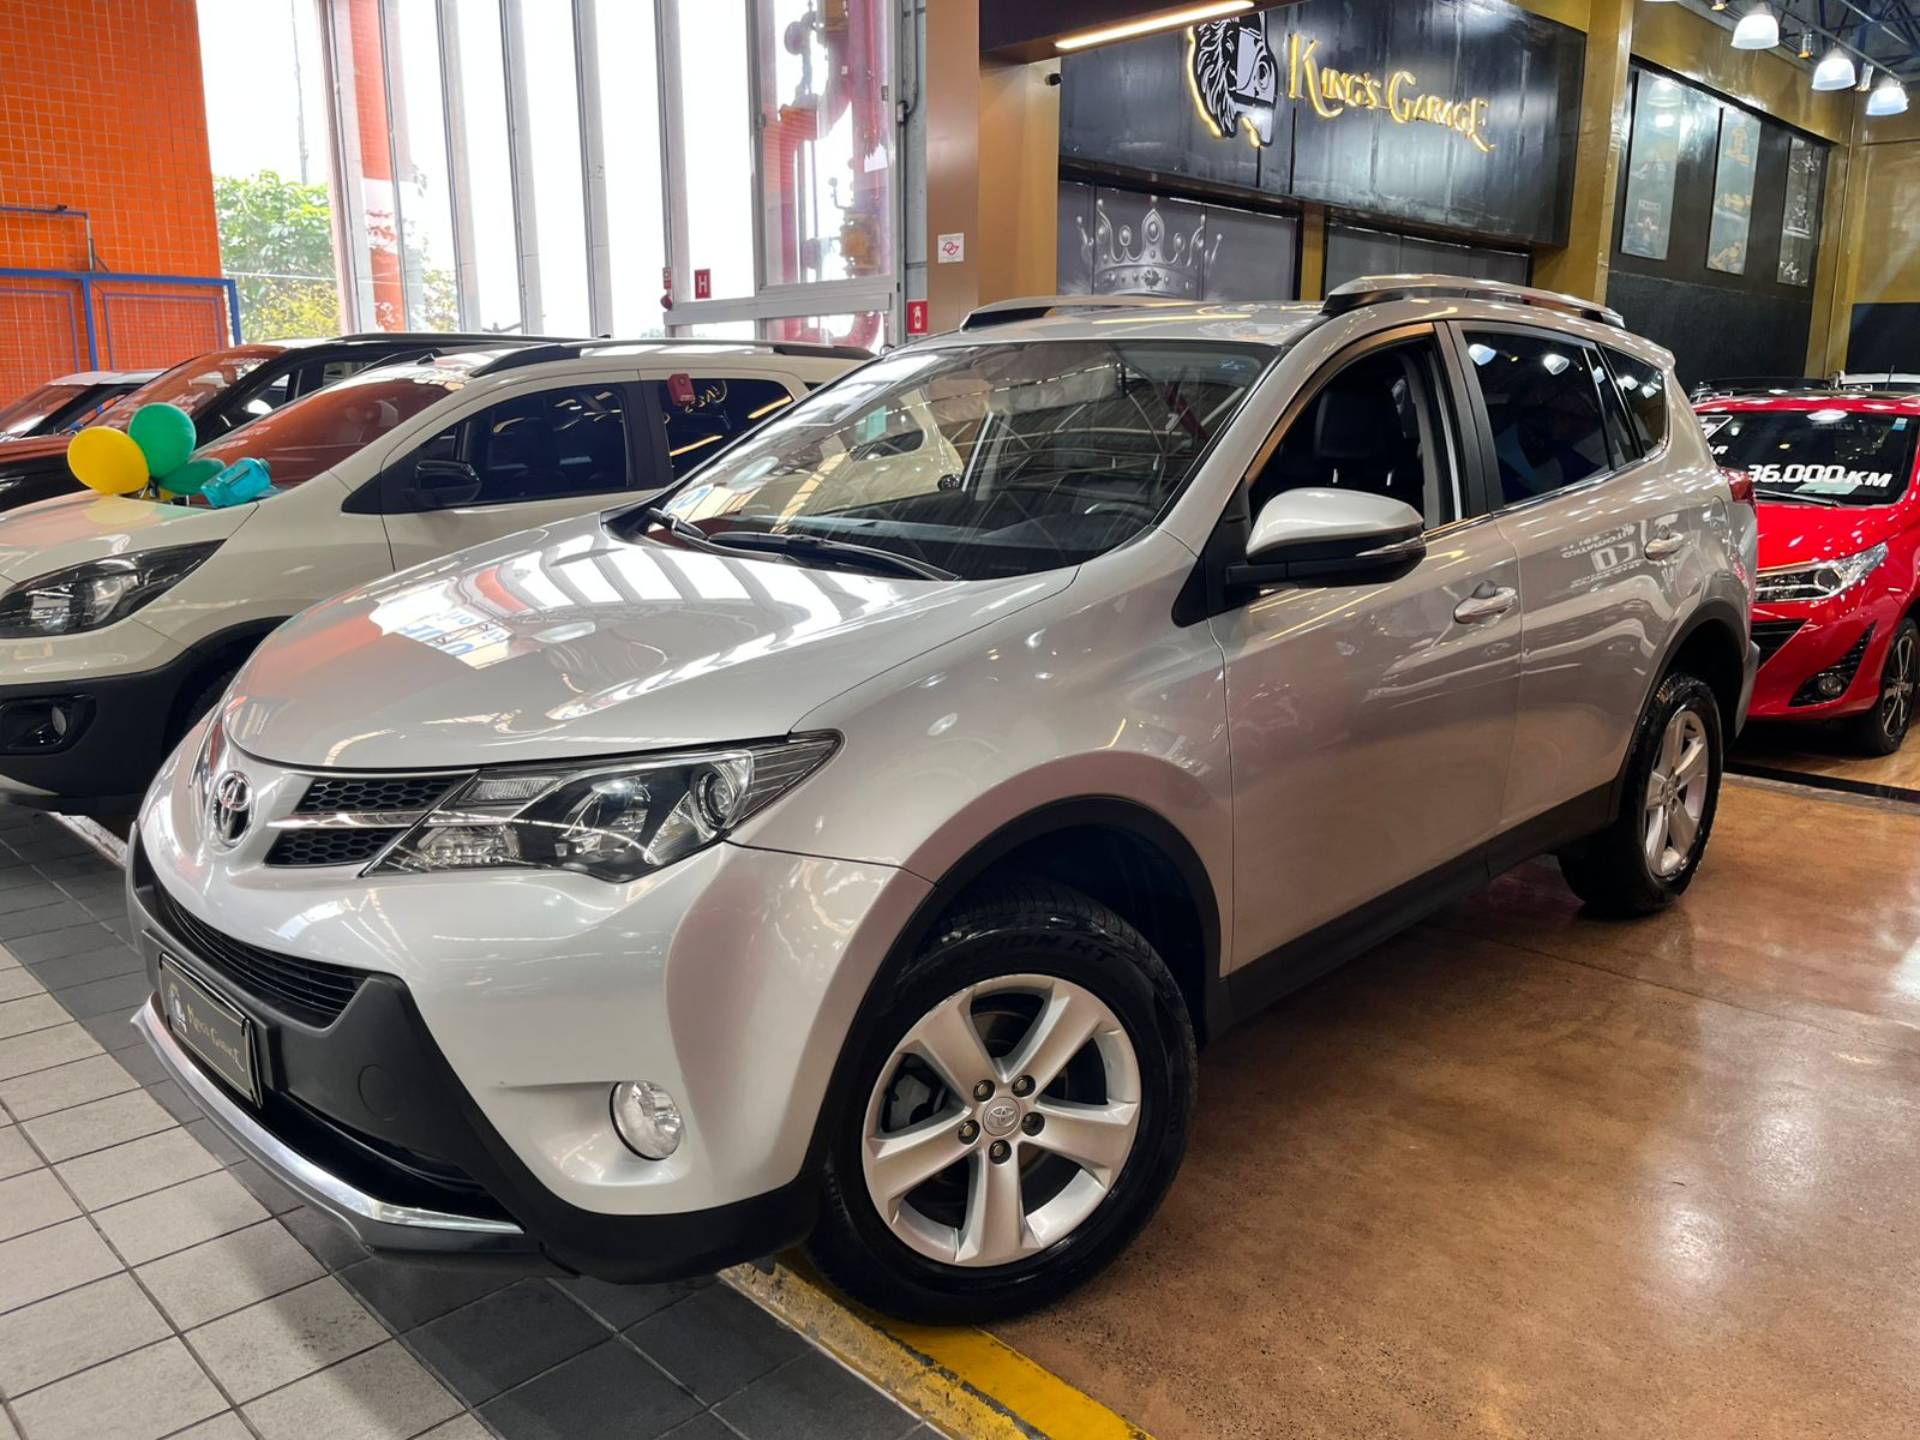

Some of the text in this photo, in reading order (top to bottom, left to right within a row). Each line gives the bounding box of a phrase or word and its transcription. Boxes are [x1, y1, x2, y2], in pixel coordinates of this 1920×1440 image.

[698, 274, 708, 294] H
[1748, 463, 1893, 488] 36.000 KM
